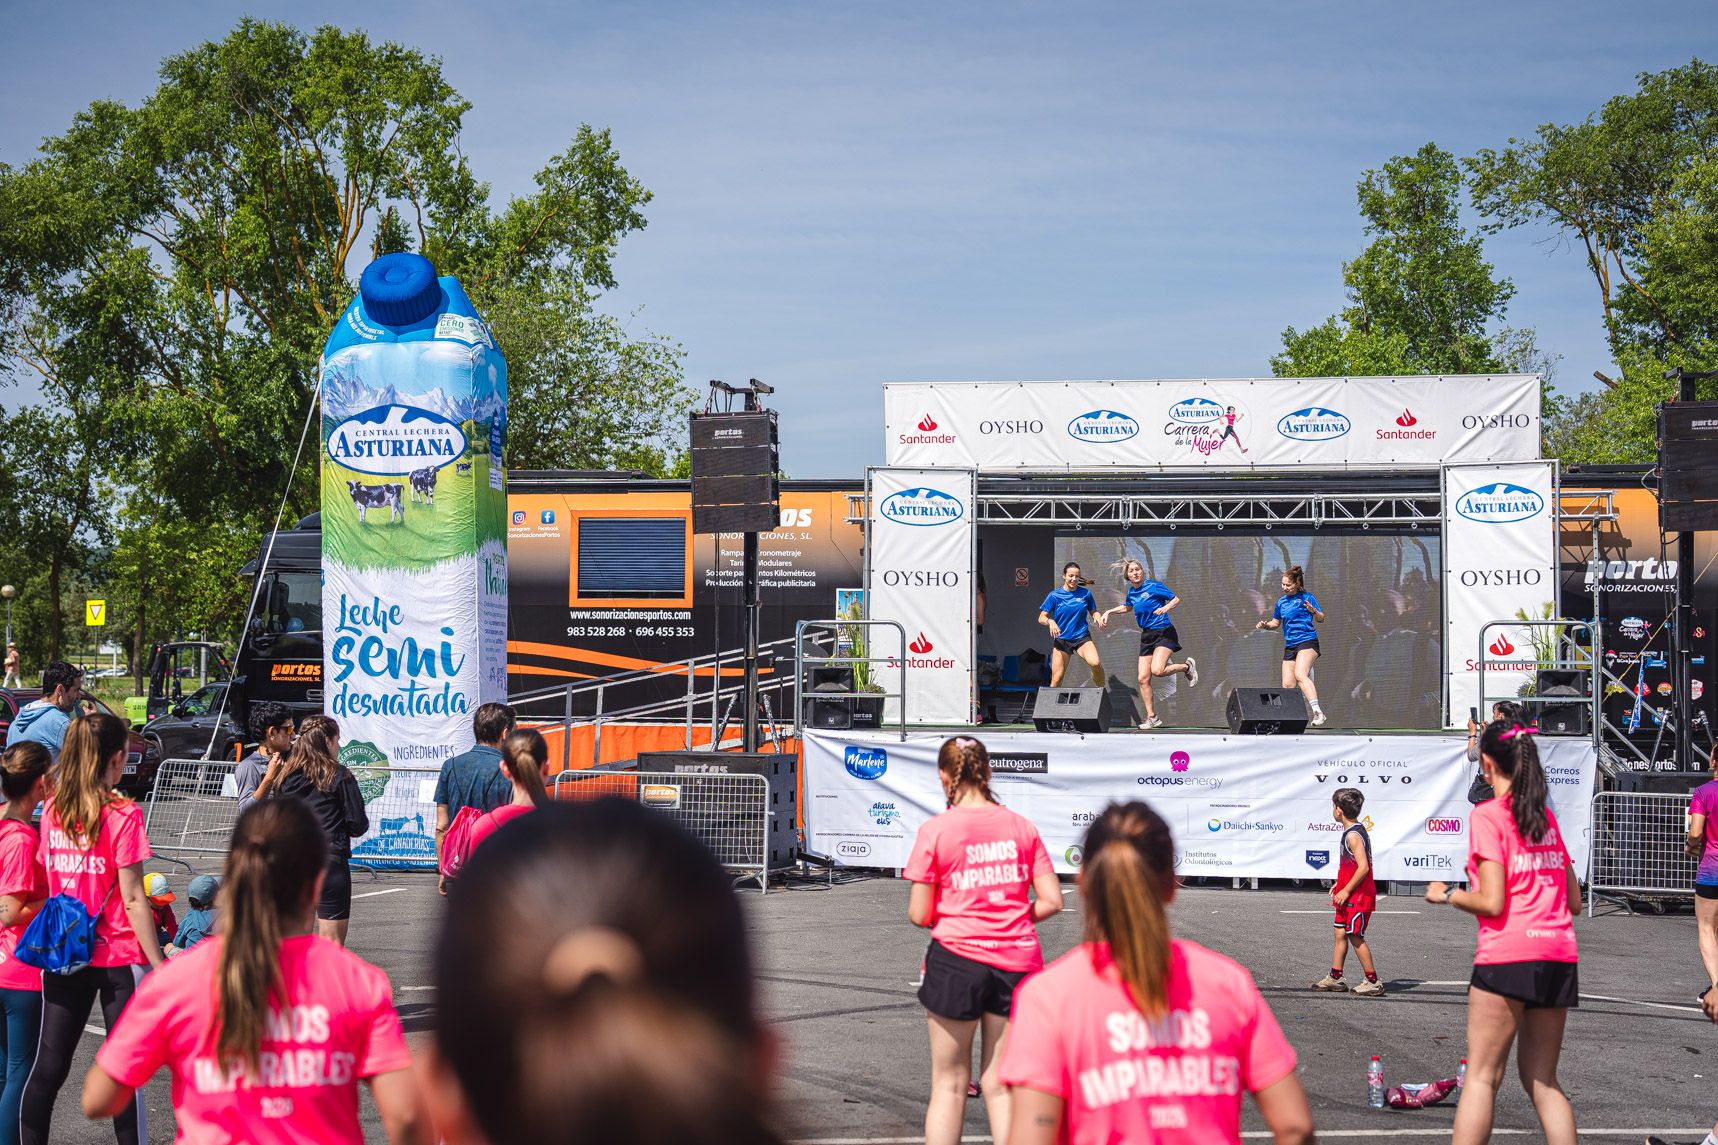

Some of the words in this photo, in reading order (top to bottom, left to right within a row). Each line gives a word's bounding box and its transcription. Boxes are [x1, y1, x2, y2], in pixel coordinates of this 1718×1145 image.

[1173, 408, 1220, 417] ASTURIANA
[979, 420, 1043, 435] OYSHO
[1074, 422, 1134, 434] ASTURIANA
[1283, 420, 1345, 433] ASTURIANA
[1462, 414, 1530, 430] OYSHO
[1164, 422, 1209, 436] Carrera
[1376, 428, 1436, 440] Santander
[335, 431, 456, 458] ASTURIANA
[900, 433, 956, 444] Santander
[1175, 436, 1184, 445] de
[1185, 436, 1192, 445] la
[1190, 434, 1225, 455] Mujer
[887, 501, 957, 517] ASTURIANA
[1462, 498, 1536, 513] ASTURIANA
[721, 549, 744, 558] Rampa
[758, 550, 802, 558] ronometraje
[1584, 557, 1678, 584] porto
[883, 570, 958, 587] OYSHO
[1461, 569, 1541, 587] OYSHO
[335, 594, 404, 637] Leche
[570, 609, 691, 622] www.sonorizacionesportos.com
[567, 626, 585, 636] 983
[587, 626, 606, 636] 528
[607, 627, 626, 636] 268
[635, 627, 654, 636] 696
[655, 627, 675, 637] 455
[676, 627, 695, 637] 353
[332, 626, 465, 682] semi
[271, 663, 321, 676] portos
[332, 680, 471, 718] desnatada
[847, 754, 885, 771] Marlene
[988, 757, 1043, 771] eutrogena
[1317, 759, 1366, 768] VEHÍCULO
[1544, 766, 1580, 775] Correos
[1137, 776, 1183, 788] octopus
[1184, 777, 1223, 789] energy
[1314, 775, 1412, 784] VOLVO
[1544, 776, 1580, 785] Express
[1224, 821, 1284, 833] Daiichi-Sankyo
[1428, 819, 1460, 832] COSMO
[841, 845, 866, 855] ziaja
[965, 839, 1018, 865] SOMOS
[1184, 858, 1232, 866] Odontológicos
[1404, 855, 1452, 867] variTek
[951, 862, 1029, 890] IMPARABLS
[266, 1004, 330, 1044] MOS
